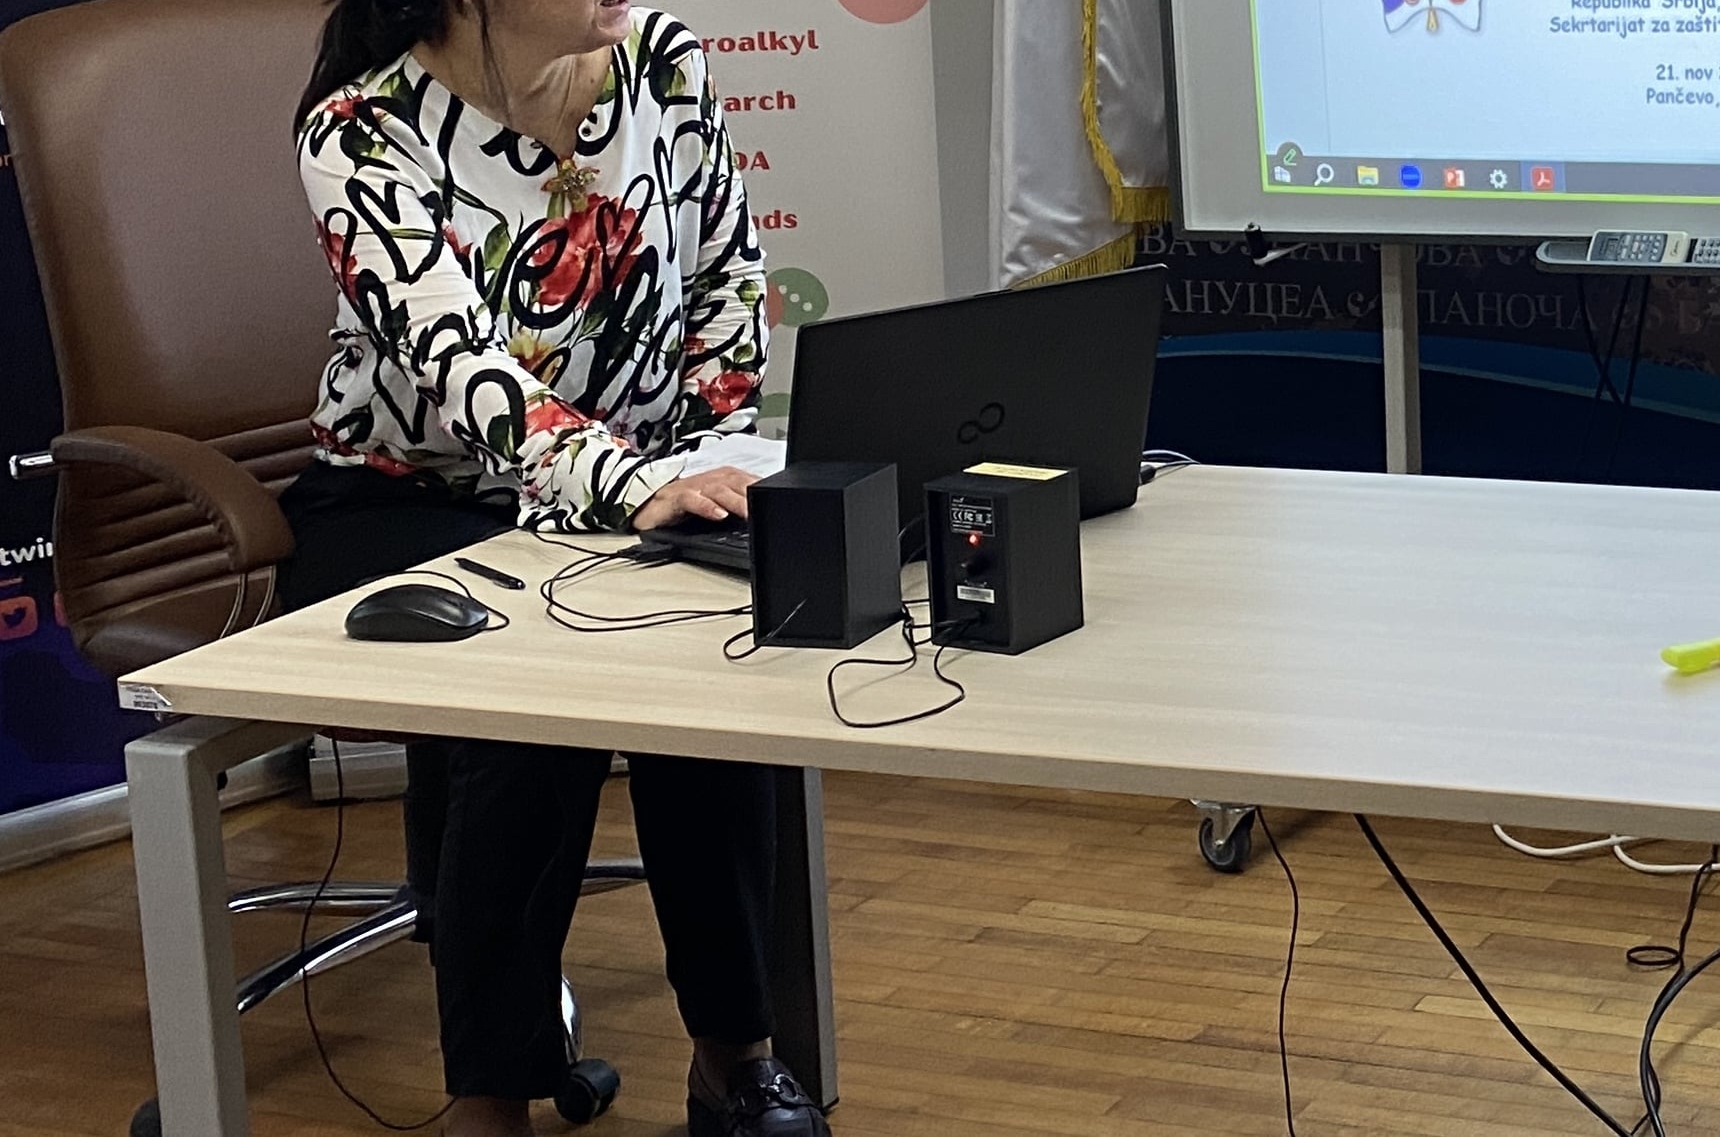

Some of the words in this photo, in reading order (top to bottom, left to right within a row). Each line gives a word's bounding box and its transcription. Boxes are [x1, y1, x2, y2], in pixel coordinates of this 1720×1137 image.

[1549, 16, 1646, 39] Sekrtarijat
[1651, 20, 1670, 33] za
[702, 30, 819, 56] roalkyl
[1655, 64, 1679, 81] 21.
[1685, 67, 1713, 81] nov
[723, 90, 796, 112] arch
[1646, 87, 1720, 108] Pančevo,
